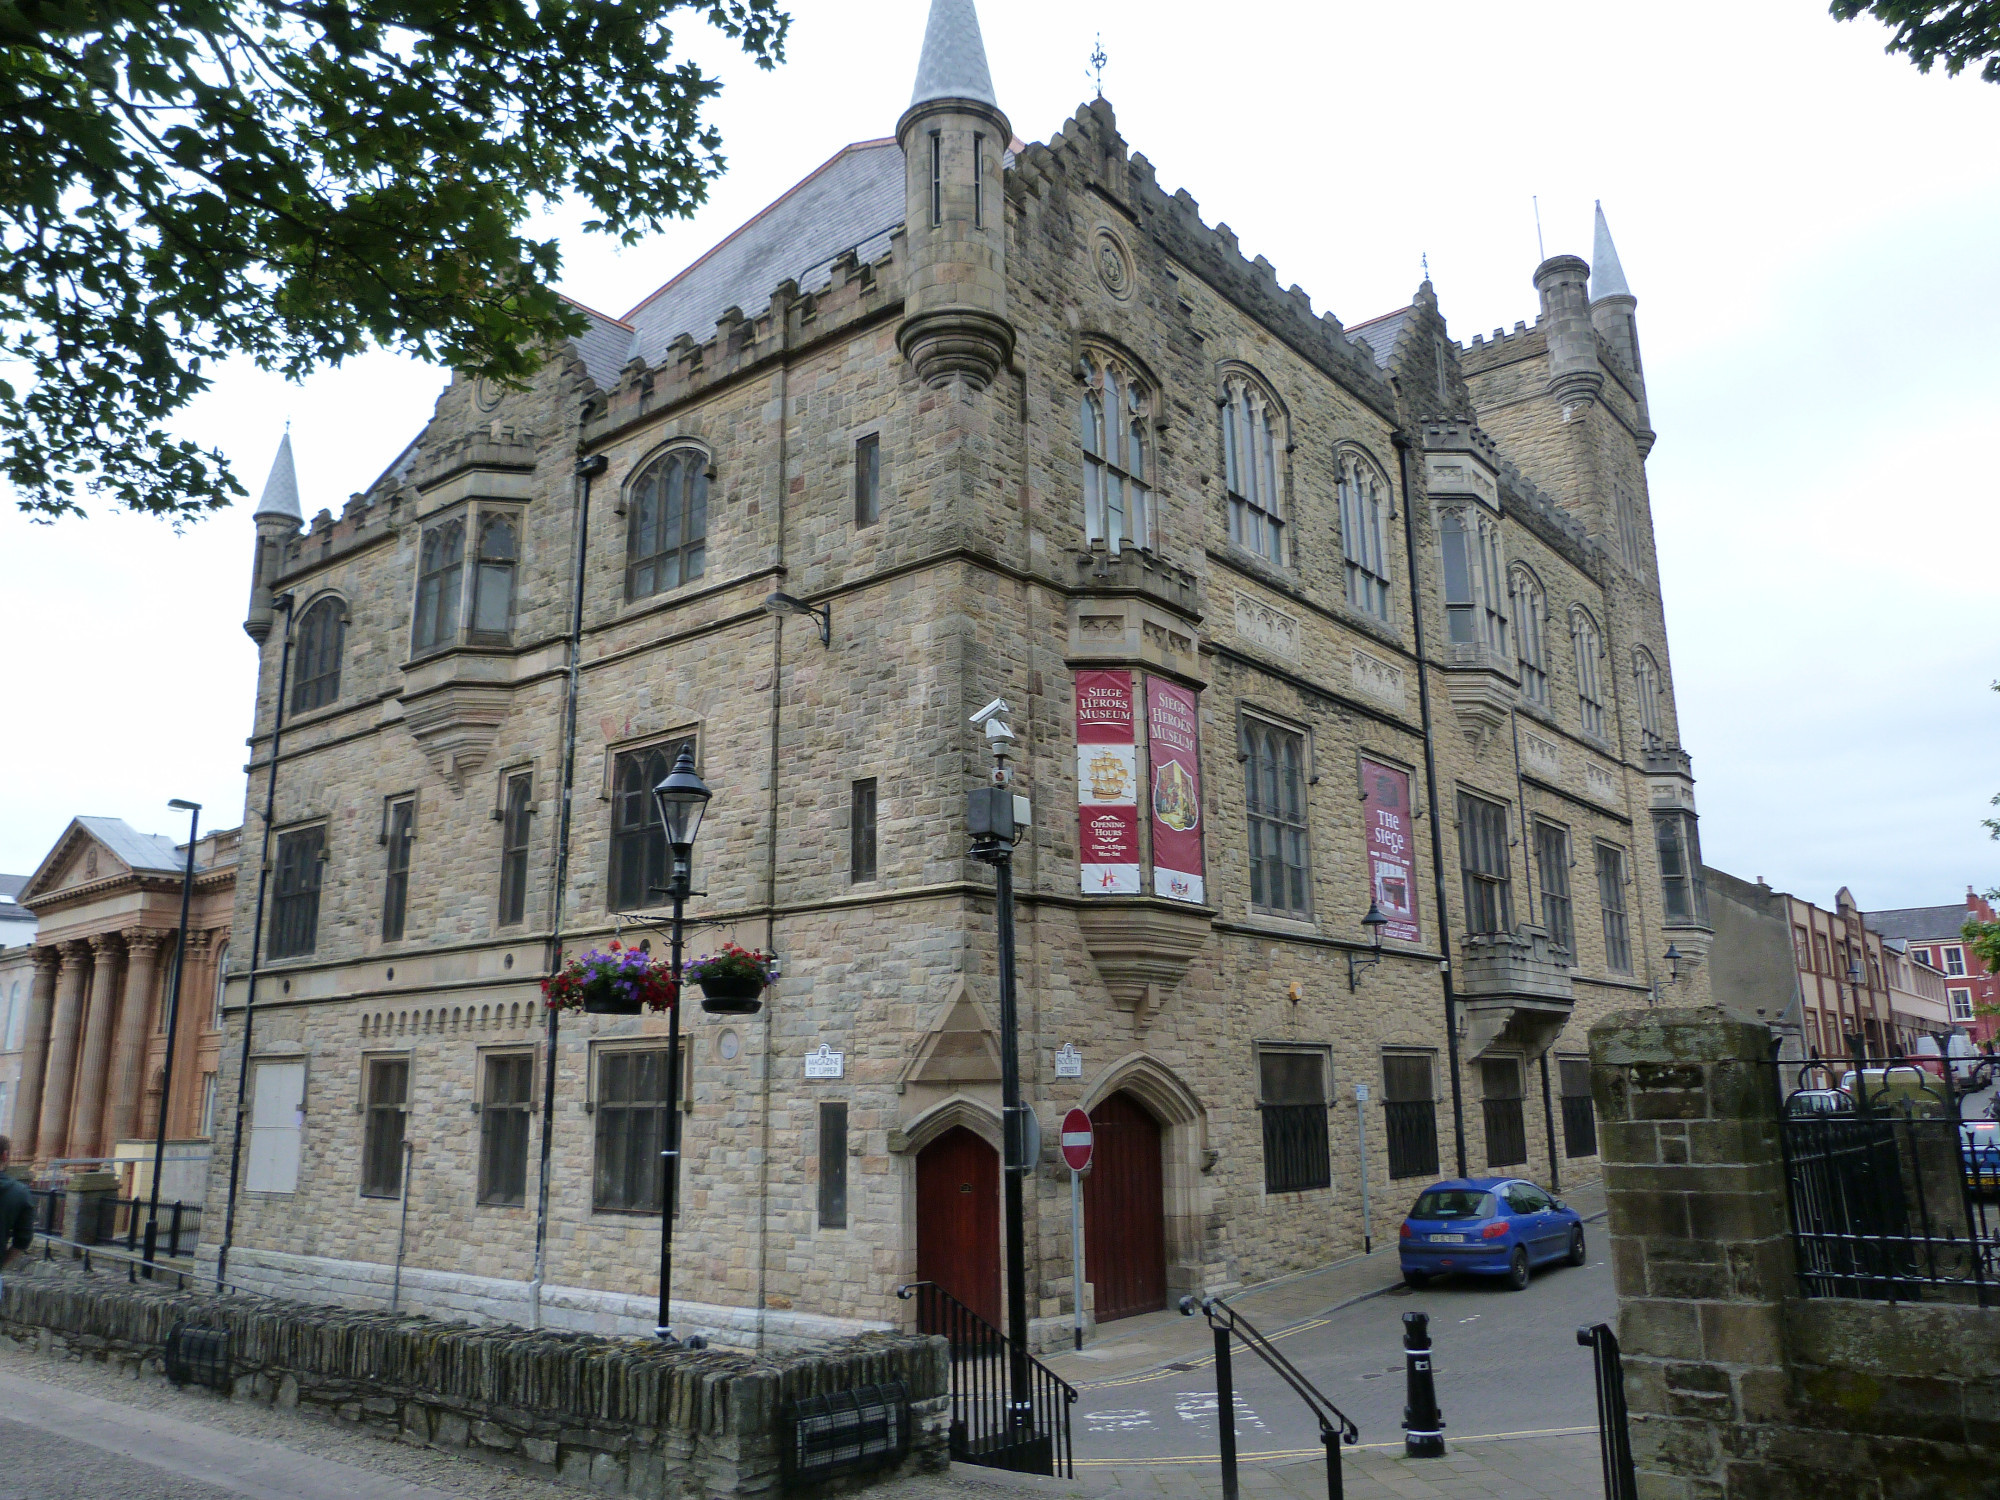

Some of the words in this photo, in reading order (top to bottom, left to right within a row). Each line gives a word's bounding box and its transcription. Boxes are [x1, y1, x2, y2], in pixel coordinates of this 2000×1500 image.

[1088, 687, 1122, 698] SIEGE
[1081, 698, 1128, 709] HEROES
[1159, 692, 1187, 716] SIEGE
[1080, 709, 1130, 720] MUSEUM
[1152, 707, 1192, 734] HEROES
[1150, 723, 1194, 751] MUSEUM
[1090, 820, 1126, 828] OPENING
[1094, 828, 1122, 836] HOURS
[808, 1057, 839, 1066] MAGAZINE
